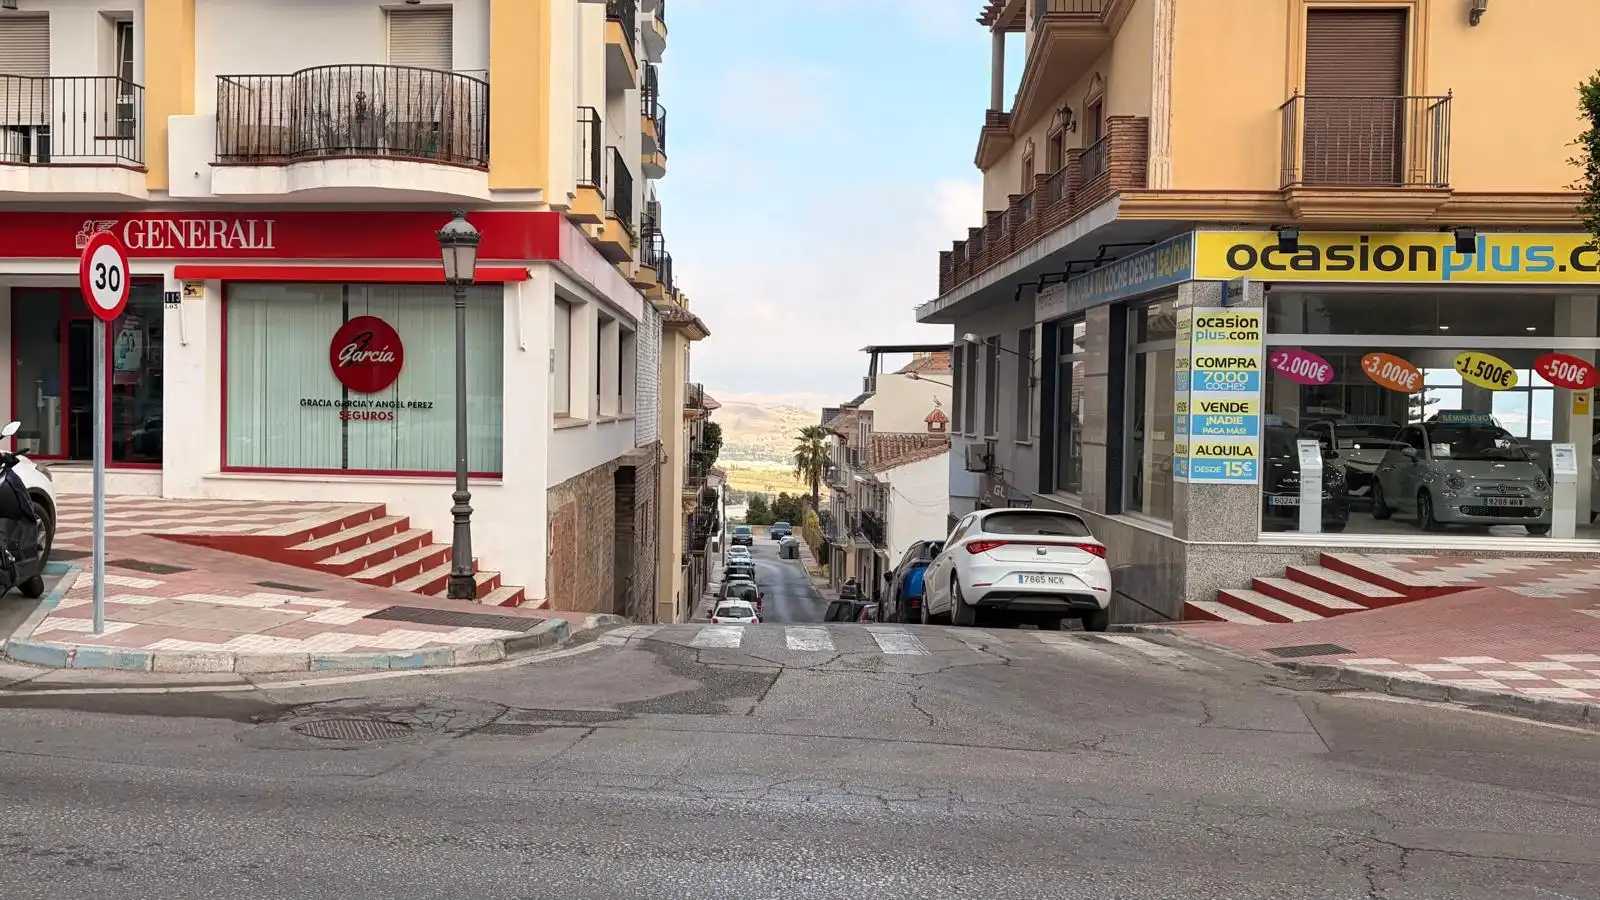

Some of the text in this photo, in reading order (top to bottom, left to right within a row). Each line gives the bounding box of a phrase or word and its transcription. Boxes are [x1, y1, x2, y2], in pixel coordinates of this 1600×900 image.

[123, 219, 275, 249] GENERALI
[1128, 252, 1155, 286] DESDE
[95, 262, 121, 292] 30
[1196, 315, 1259, 328] ocasion
[1196, 329, 1259, 342] plus.com
[338, 344, 396, 368] García
[1196, 357, 1257, 368] COMPRA
[1272, 353, 1328, 382] -2.000€
[1364, 356, 1419, 390] -3.000€
[1457, 356, 1512, 387] -1.500€
[1543, 359, 1588, 385] -500€
[1203, 371, 1249, 383] 7000
[1205, 382, 1246, 391] COCHES
[300, 399, 332, 407] GRACIA
[1201, 402, 1249, 413] VENDE
[339, 410, 394, 421] SEGUROS
[1202, 427, 1226, 435] PAGA
[1196, 445, 1253, 456] ALQUILA
[1194, 465, 1222, 473] DESDE
[1223, 460, 1253, 477] 15€
[1024, 576, 1064, 585] 7865 NCK
